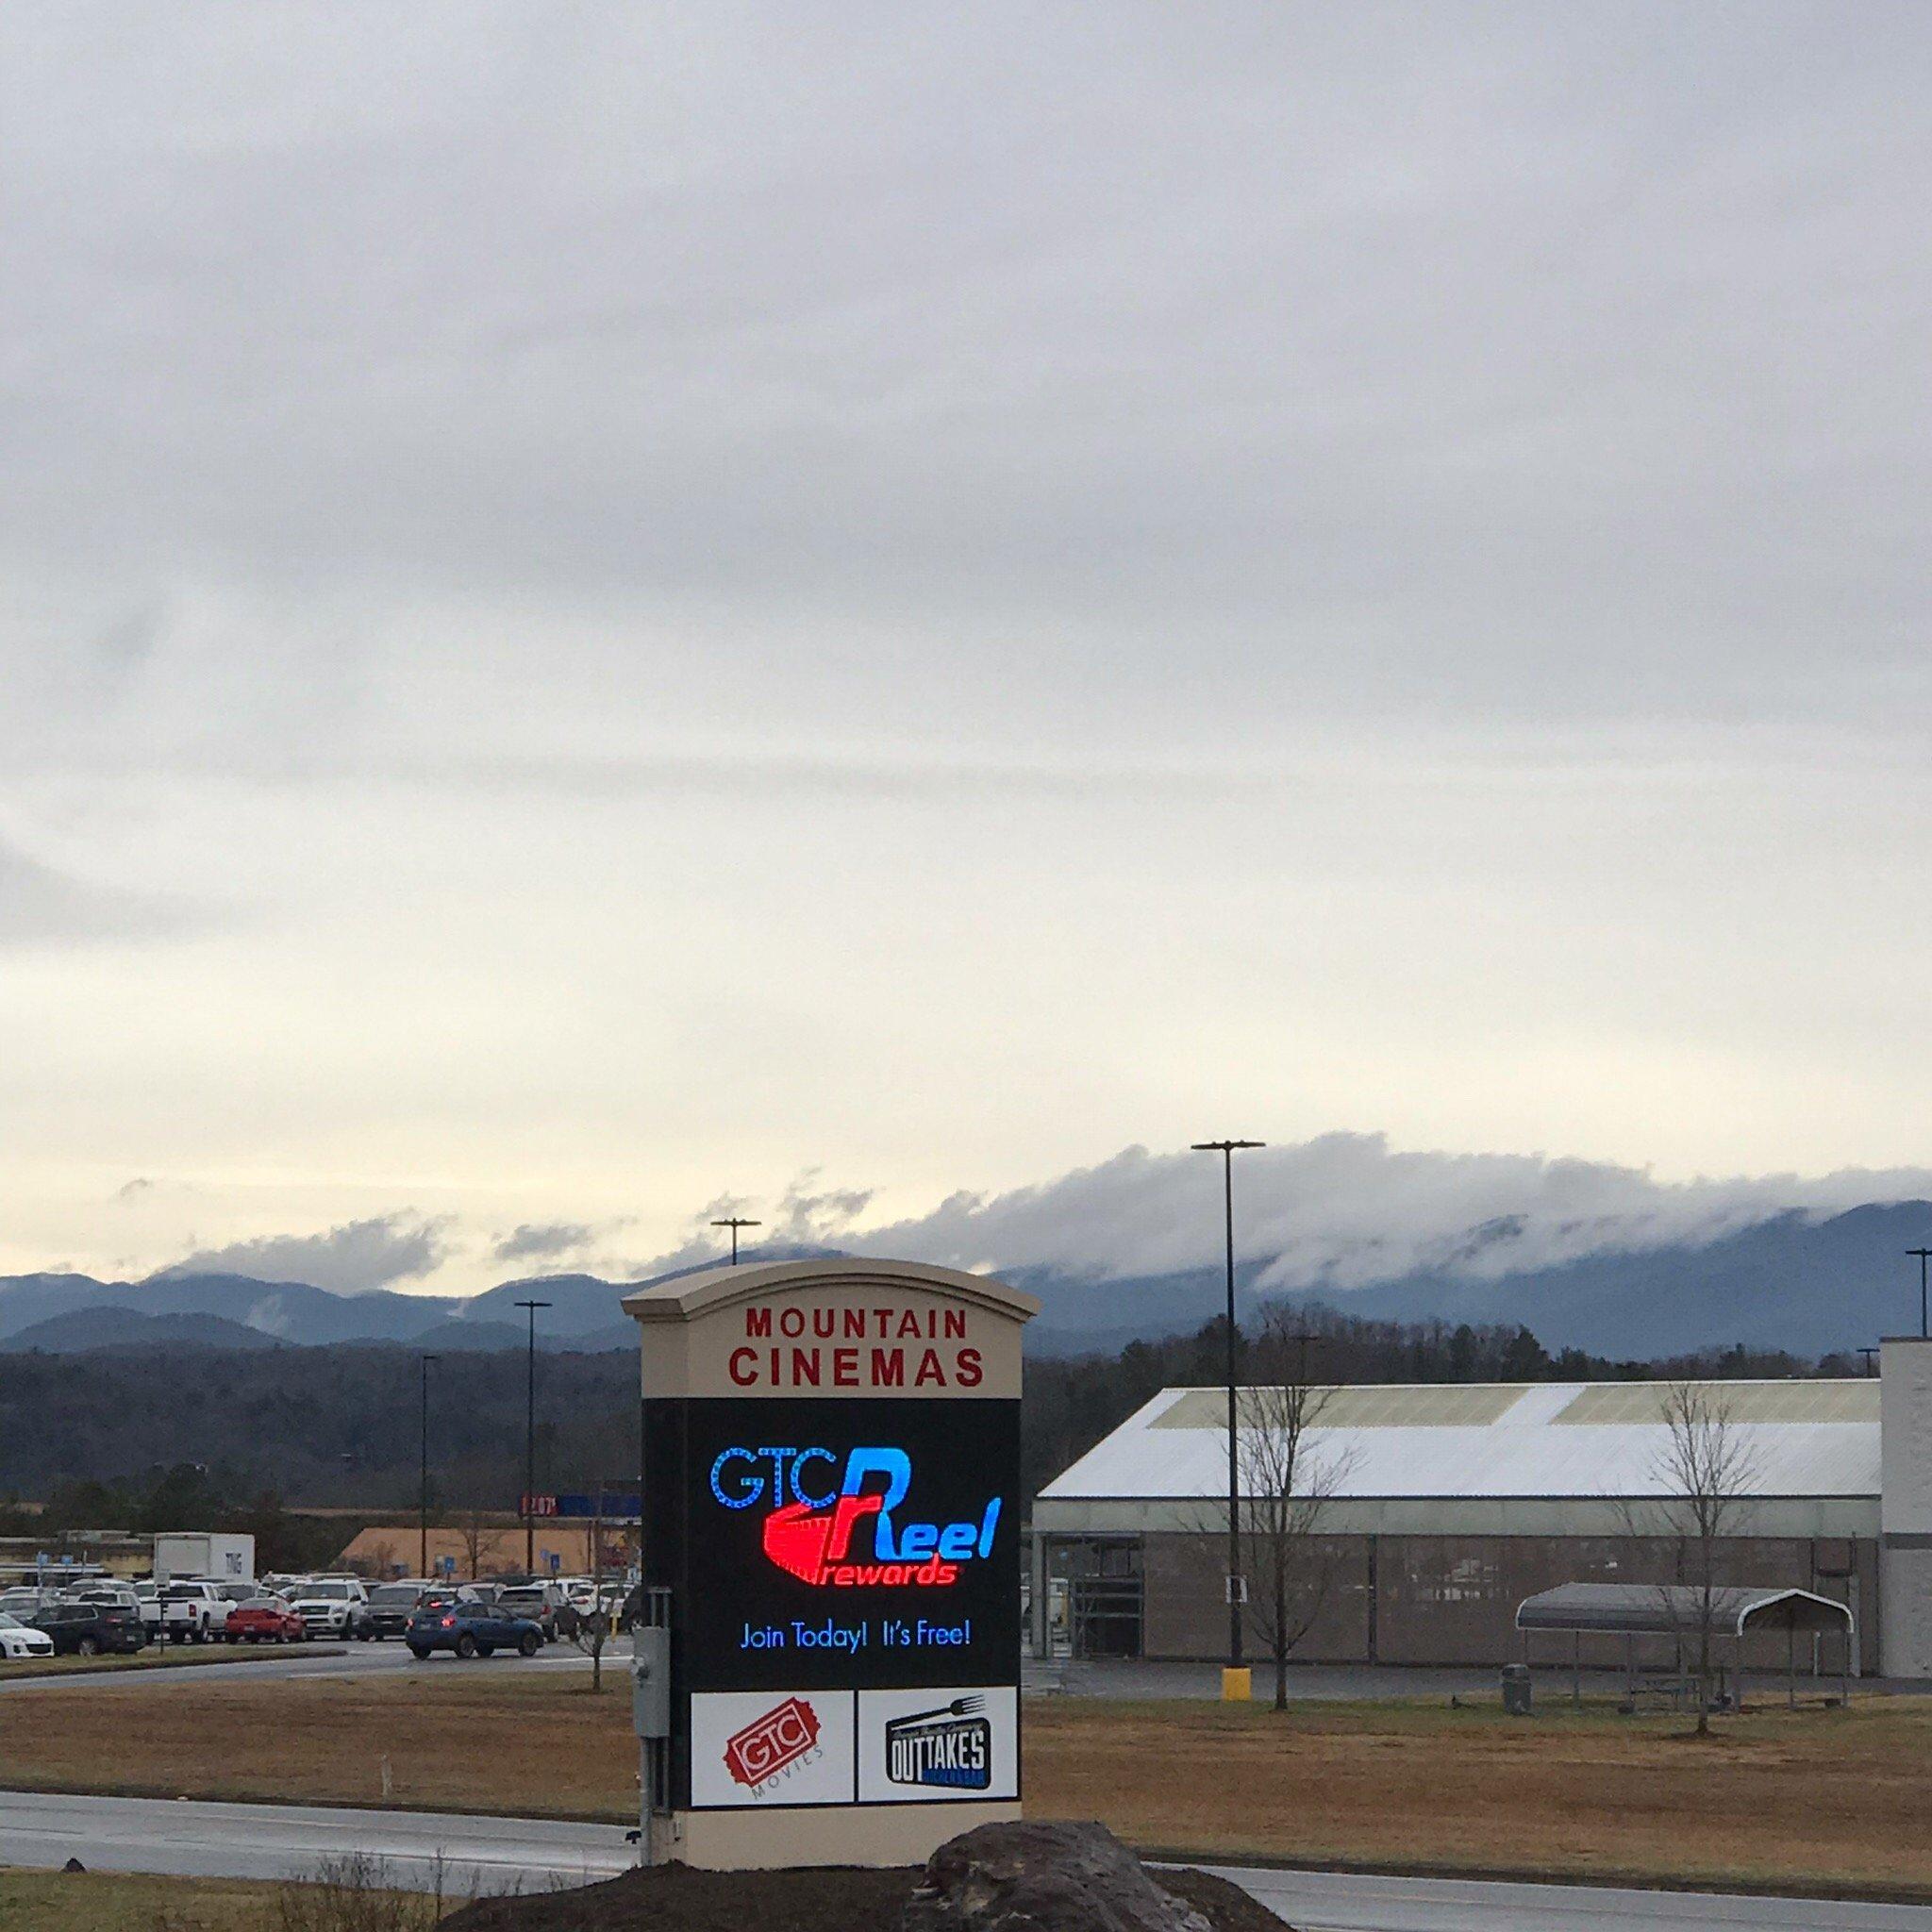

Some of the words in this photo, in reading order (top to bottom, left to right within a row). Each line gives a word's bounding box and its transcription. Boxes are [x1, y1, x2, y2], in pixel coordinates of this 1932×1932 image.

[746, 1307, 966, 1339] MOUNTAIN
[728, 1346, 984, 1388] CINEMAS
[709, 1447, 838, 1509] GTC
[820, 1552, 958, 1587] rewards
[741, 1622, 785, 1649] Join
[791, 1618, 867, 1655] Today!
[883, 1620, 911, 1646] It's
[917, 1619, 972, 1645] Free!
[741, 1714, 805, 1771] GTC
[891, 1729, 985, 1782] OUTTAKES
[751, 1744, 824, 1800] MOVIES
